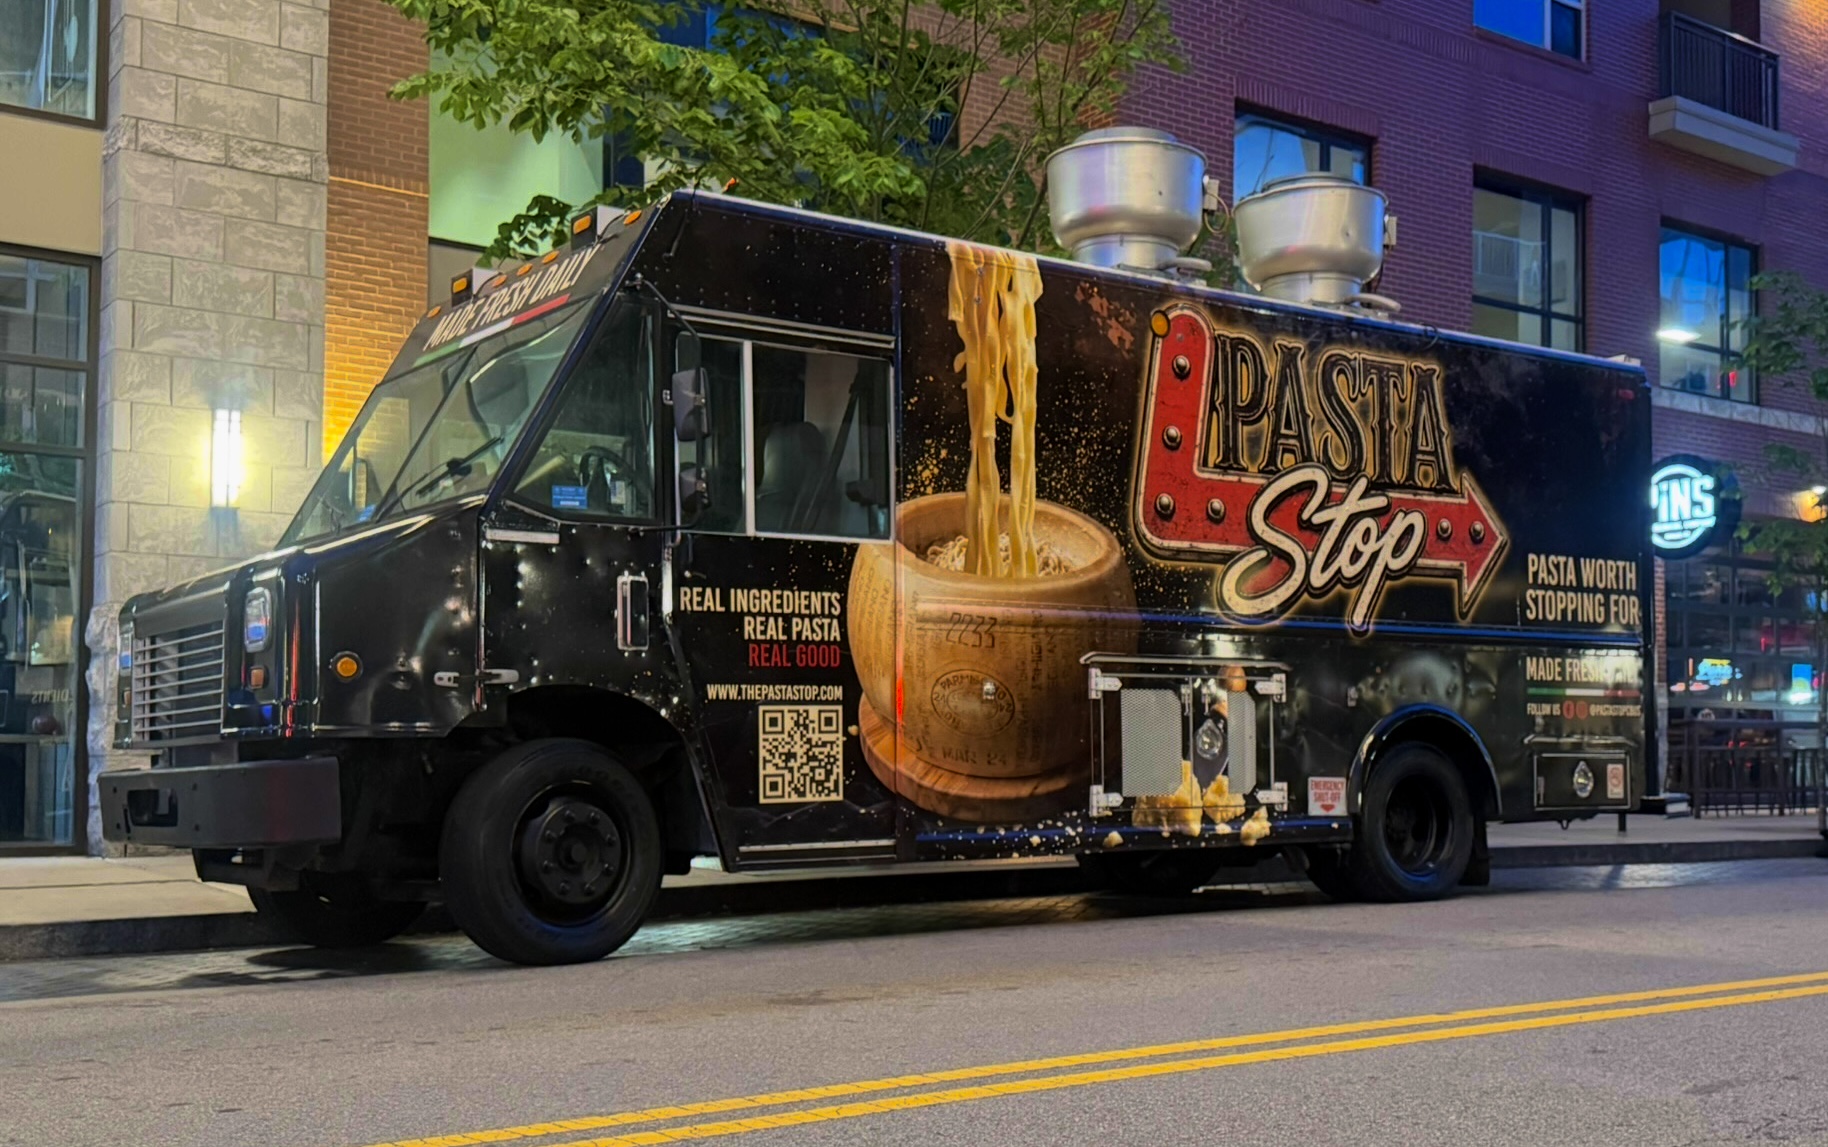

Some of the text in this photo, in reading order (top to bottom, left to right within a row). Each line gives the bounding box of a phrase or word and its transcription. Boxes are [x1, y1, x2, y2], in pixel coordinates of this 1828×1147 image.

[423, 243, 602, 351] MADE FRESH DAILY
[1214, 331, 1461, 493] PASTA
[1218, 463, 1428, 634] Stop
[1527, 553, 1637, 590] PASTA WORTH
[680, 586, 842, 616] REAL INGREDIENTS
[1526, 589, 1640, 625] STOPPING FOR
[744, 616, 841, 642] REAL PASTA
[749, 643, 841, 667] REAL GOOD
[1526, 656, 1563, 681] MADE
[706, 684, 843, 701] WWW.THEPASTASTOP.COM
[1527, 703, 1551, 715] FOLLOW
[1552, 703, 1560, 715] US
[1311, 780, 1344, 790] EMERGENCY
